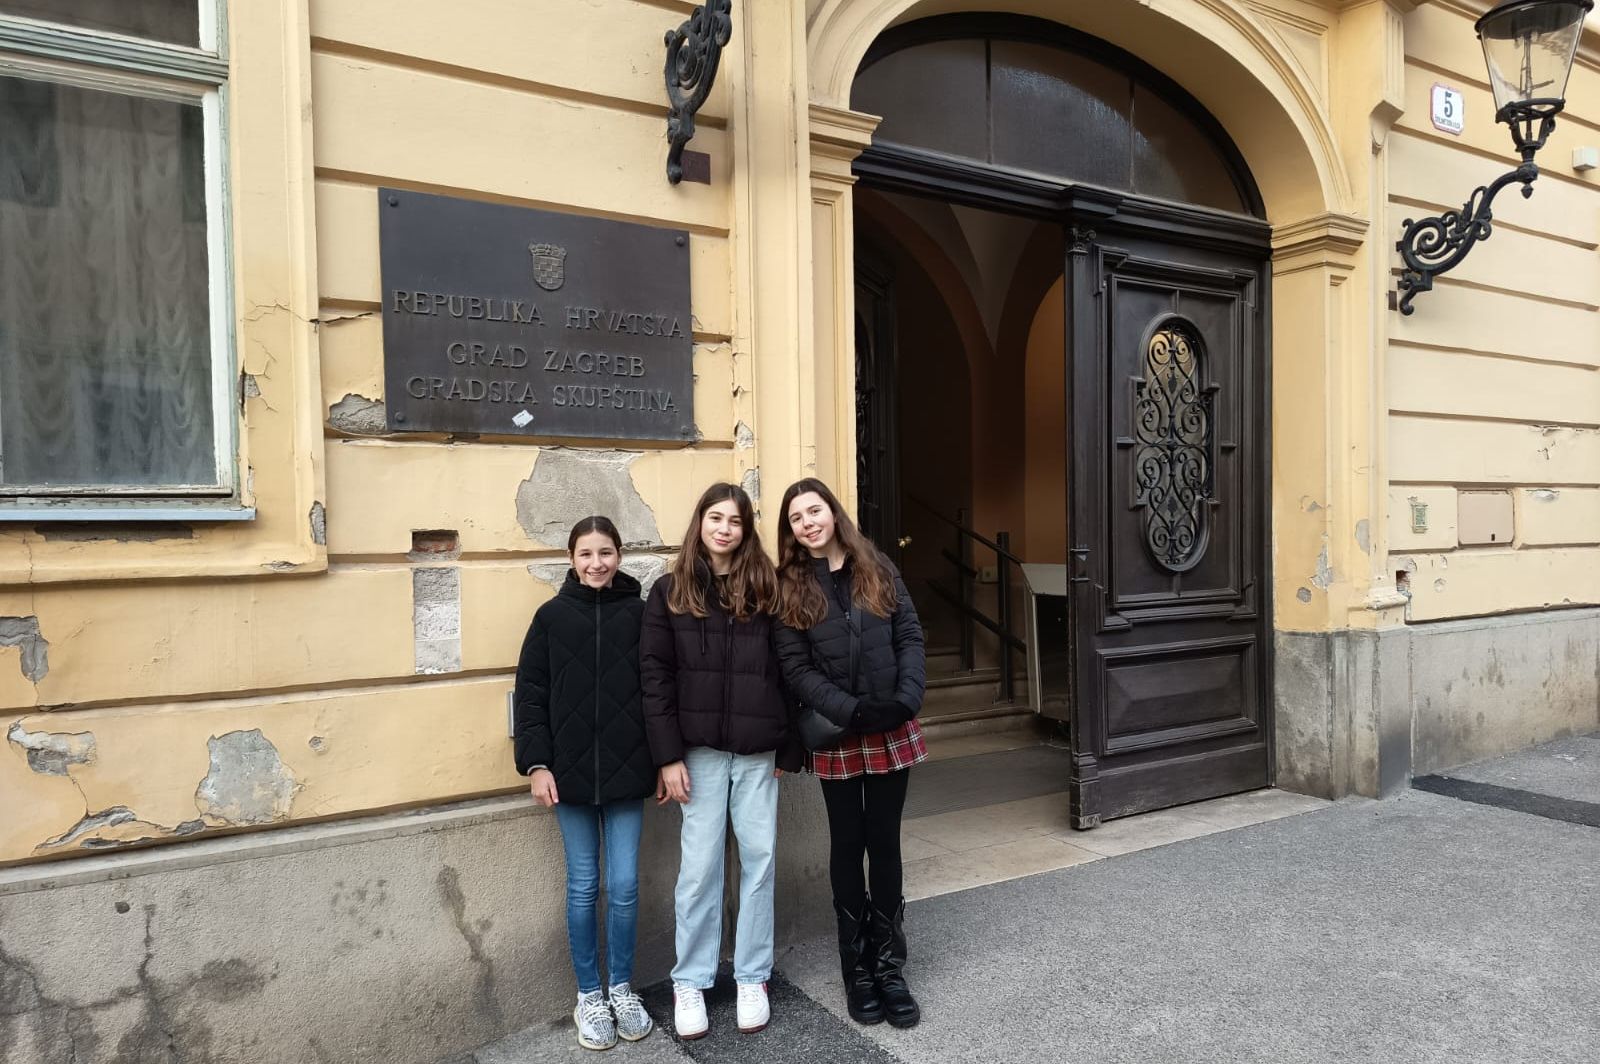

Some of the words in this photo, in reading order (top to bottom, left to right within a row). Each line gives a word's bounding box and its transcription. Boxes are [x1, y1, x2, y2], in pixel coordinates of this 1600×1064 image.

[1444, 91, 1453, 118] 5
[392, 289, 544, 325] REPUBLIKA
[564, 305, 684, 338] HRVATSKA
[447, 342, 528, 369] GRAD
[543, 349, 646, 377] ZAGREB
[406, 376, 538, 404] GRADSKA
[552, 384, 680, 413] SKUPŠTINA
